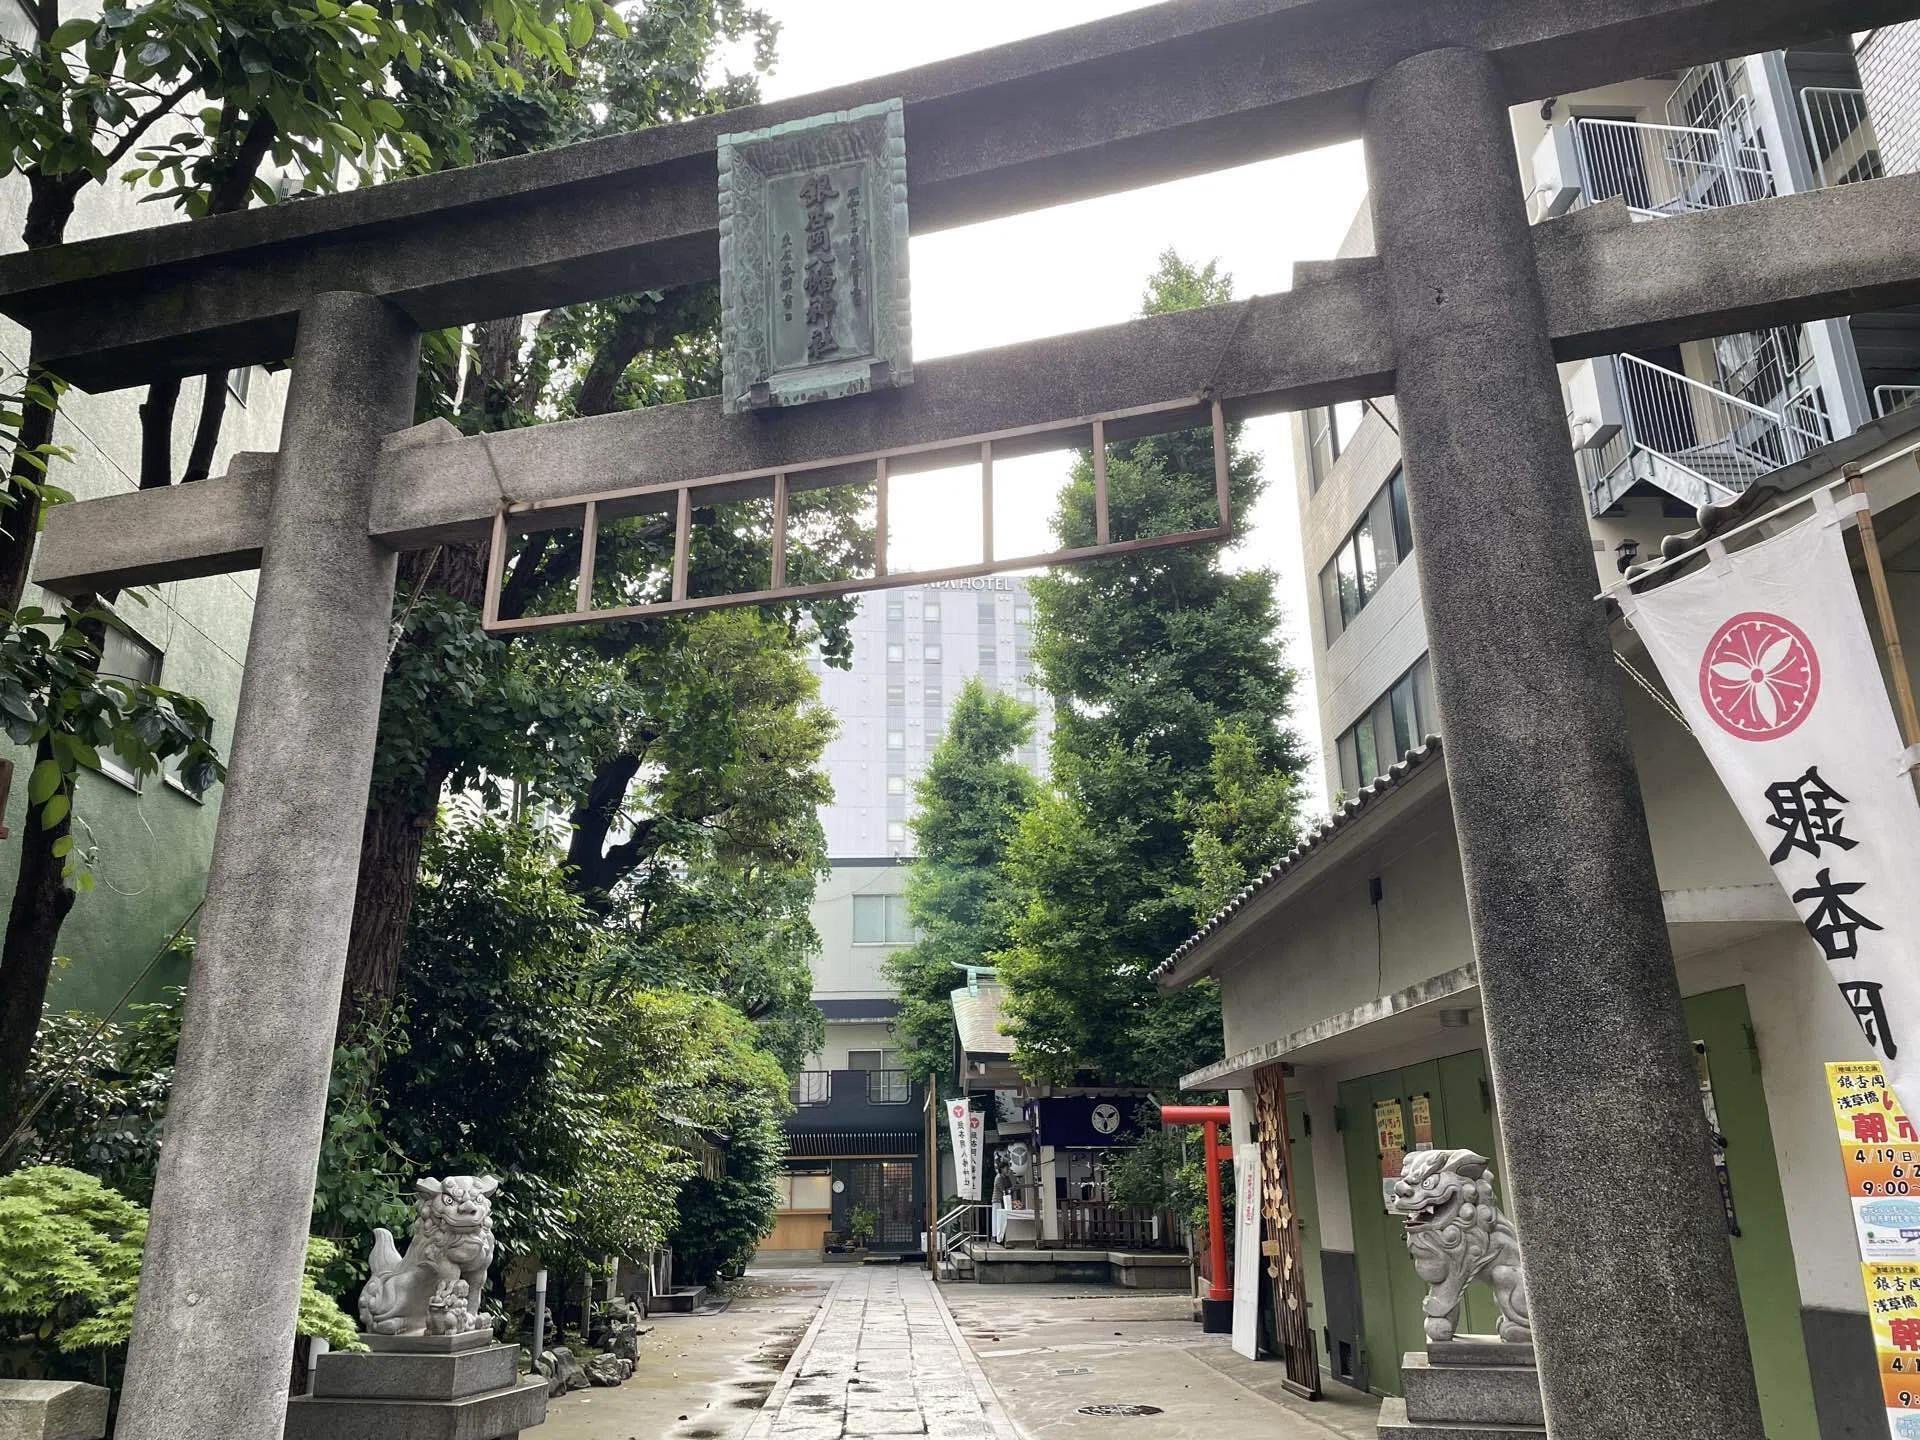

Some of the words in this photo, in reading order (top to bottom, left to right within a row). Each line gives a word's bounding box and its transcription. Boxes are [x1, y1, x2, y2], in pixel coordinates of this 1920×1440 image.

[960, 577, 1013, 591] HOTEL
[1837, 1074, 1886, 1089] 銀杏岡
[1837, 1090, 1880, 1110] 浅草橋
[1873, 1294, 1918, 1314] 浅草橋
